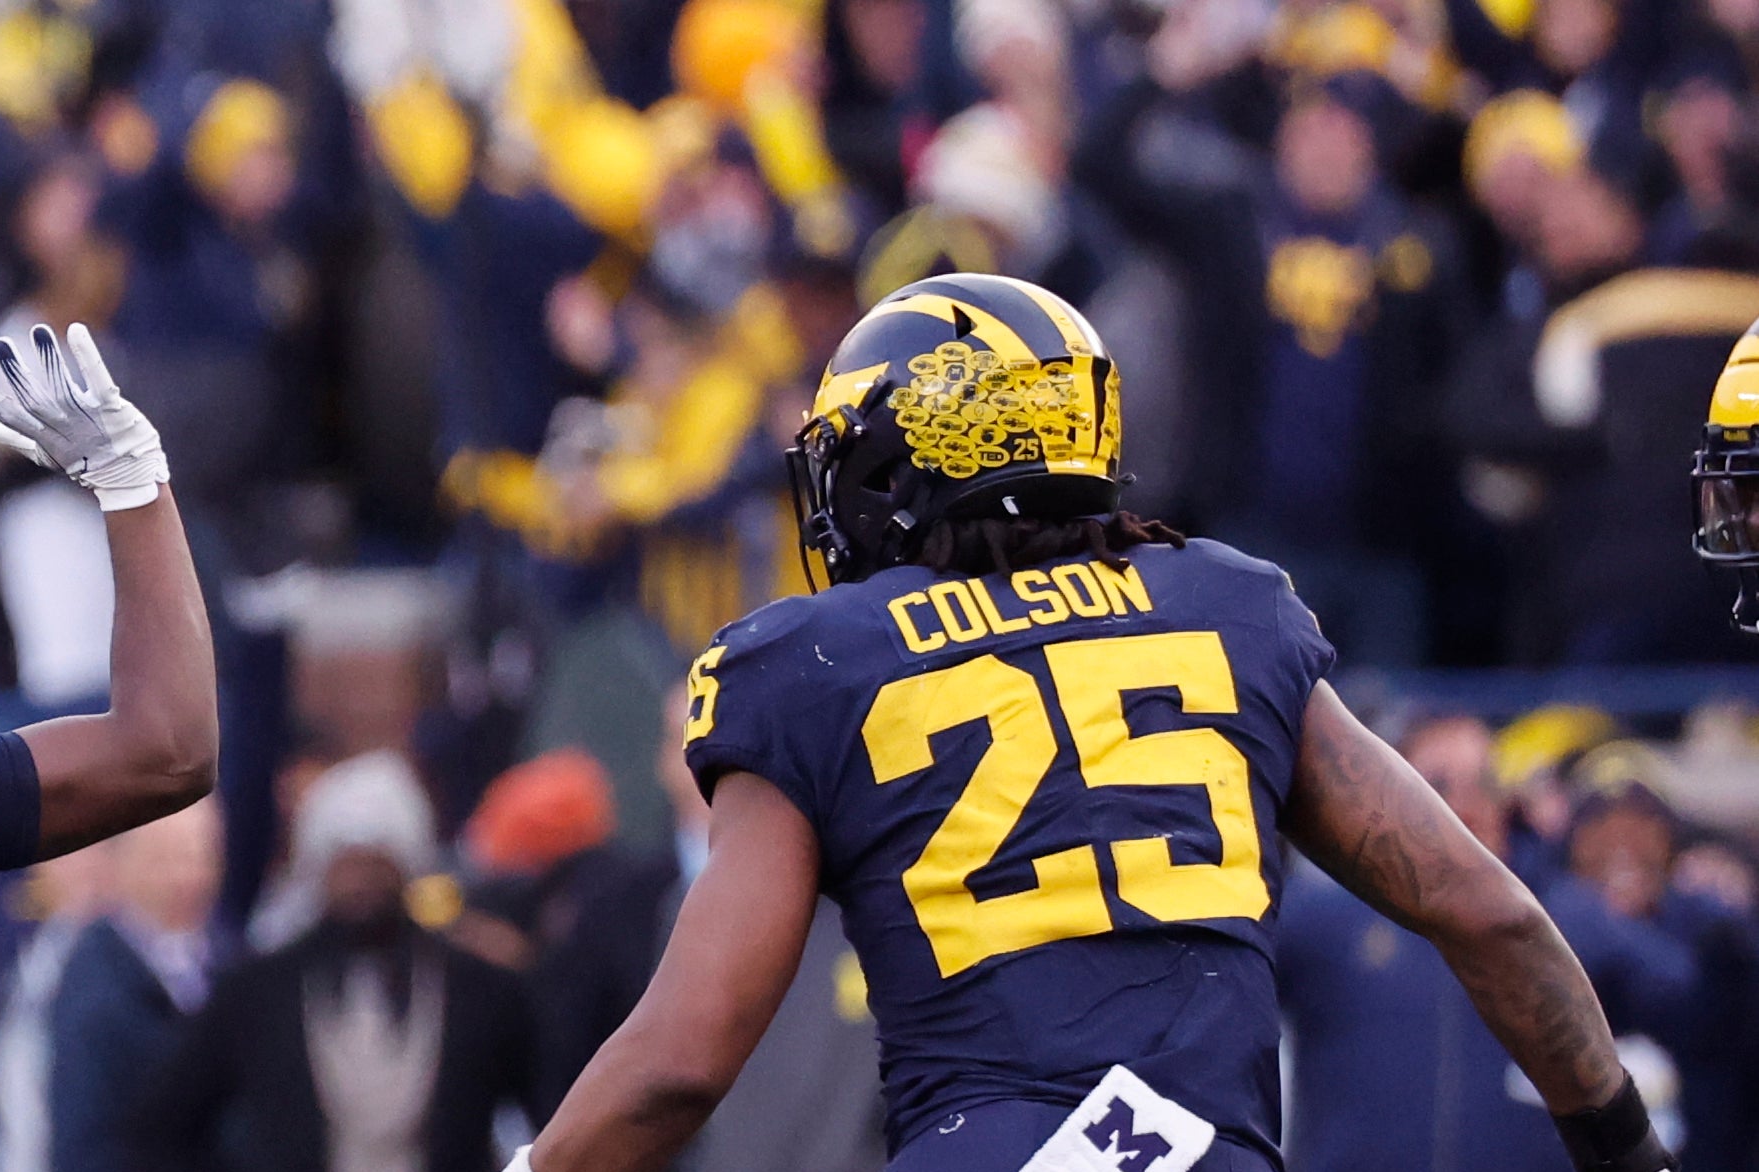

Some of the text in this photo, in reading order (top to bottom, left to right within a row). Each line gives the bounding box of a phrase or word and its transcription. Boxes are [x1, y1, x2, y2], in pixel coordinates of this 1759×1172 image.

[1012, 438, 1039, 461] 25
[887, 558, 1153, 653] COLSON
[683, 645, 728, 750] 5
[861, 631, 1270, 979] 25
